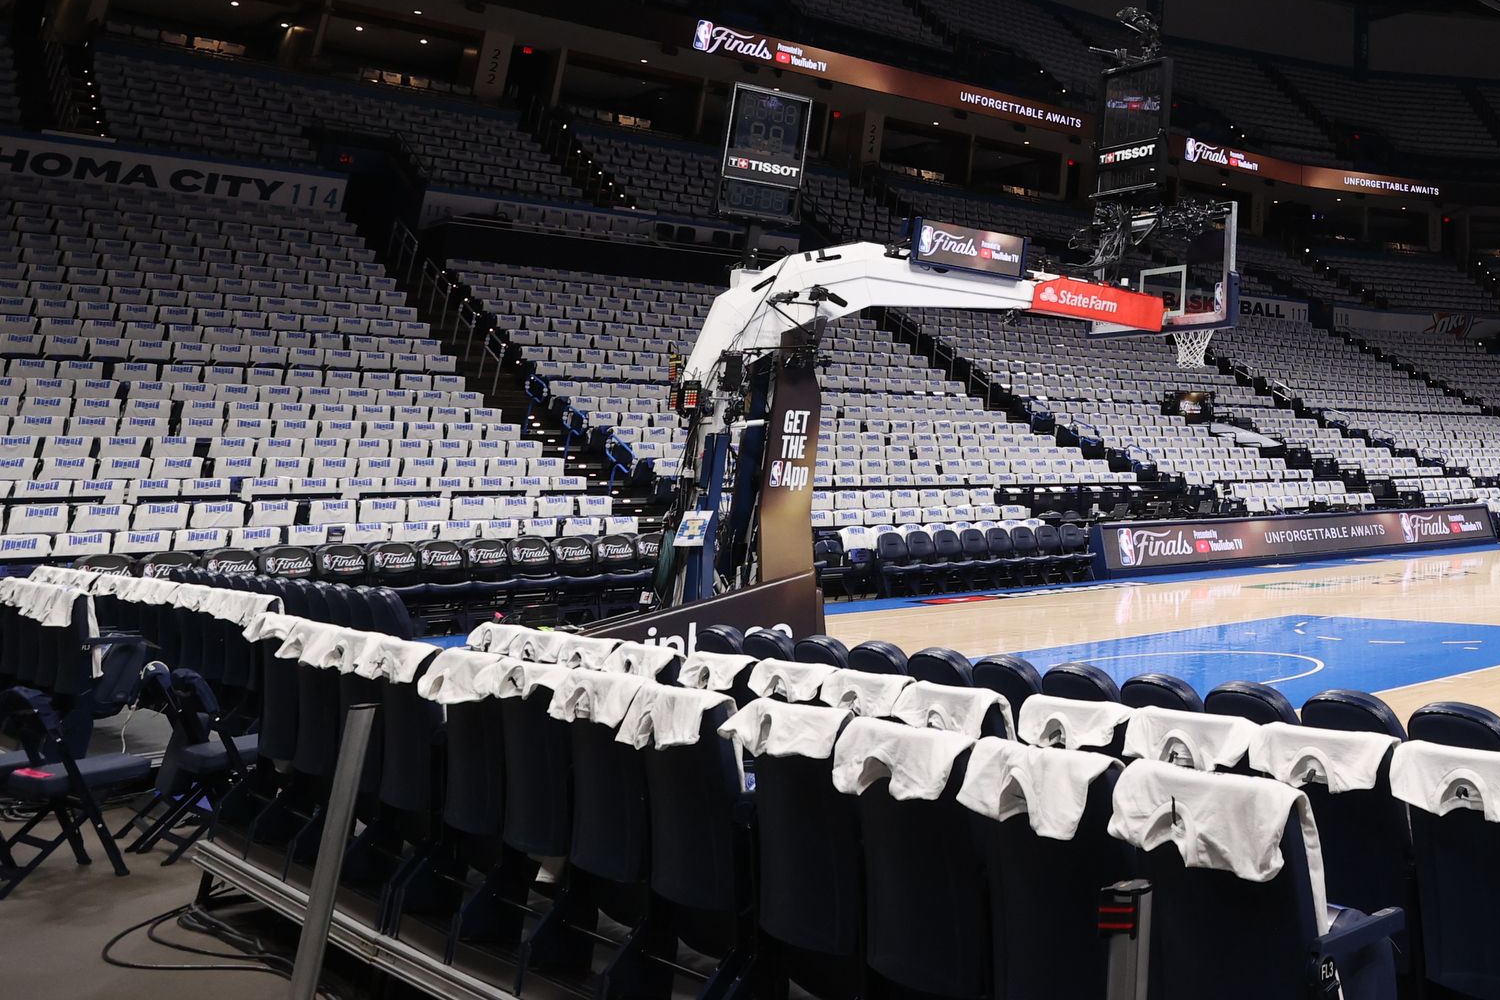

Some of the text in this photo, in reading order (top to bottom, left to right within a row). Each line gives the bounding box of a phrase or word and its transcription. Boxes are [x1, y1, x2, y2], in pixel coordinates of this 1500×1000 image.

[706, 26, 772, 61] Finals
[486, 49, 501, 85] 222
[790, 55, 827, 73] YouTube TV
[960, 91, 1082, 129] UNFORGETTABLE AWAITS
[1114, 144, 1156, 163] TISSOT
[1192, 141, 1228, 165] Finals
[748, 160, 800, 177] TISSOT
[169, 168, 285, 202] CITY
[291, 183, 338, 209] 114
[1344, 176, 1440, 196] UNFORGETTABLE AWAITS
[926, 231, 978, 256] Finals
[783, 410, 810, 435] GET
[781, 435, 808, 460] THE
[781, 461, 809, 490] App
[26, 481, 59, 491] THUNDER
[82, 480, 113, 490] THUNDER
[139, 479, 169, 489] THUNDER
[193, 479, 221, 489] THUNDER
[25, 507, 58, 517] THUNDER
[88, 505, 120, 516] THUNDER
[148, 504, 178, 514] THUNDER
[187, 530, 218, 541] THUNDER
[243, 528, 271, 539] THUNDER
[1265, 523, 1385, 544] UNFORGETTABLE AWAITS
[1411, 515, 1451, 541] Finals
[1, 538, 37, 550] THUNDER
[68, 534, 103, 547] THUNDER
[127, 531, 160, 543] THUNDER
[1208, 538, 1243, 552] YouTube TV
[519, 545, 550, 558] Finals
[603, 543, 633, 555] Finals
[1135, 529, 1193, 566] Finals
[276, 556, 313, 571] Finals
[331, 554, 365, 570] Finals
[382, 552, 416, 568] Finals
[429, 550, 462, 563] Finals
[1321, 961, 1335, 980] FL3
